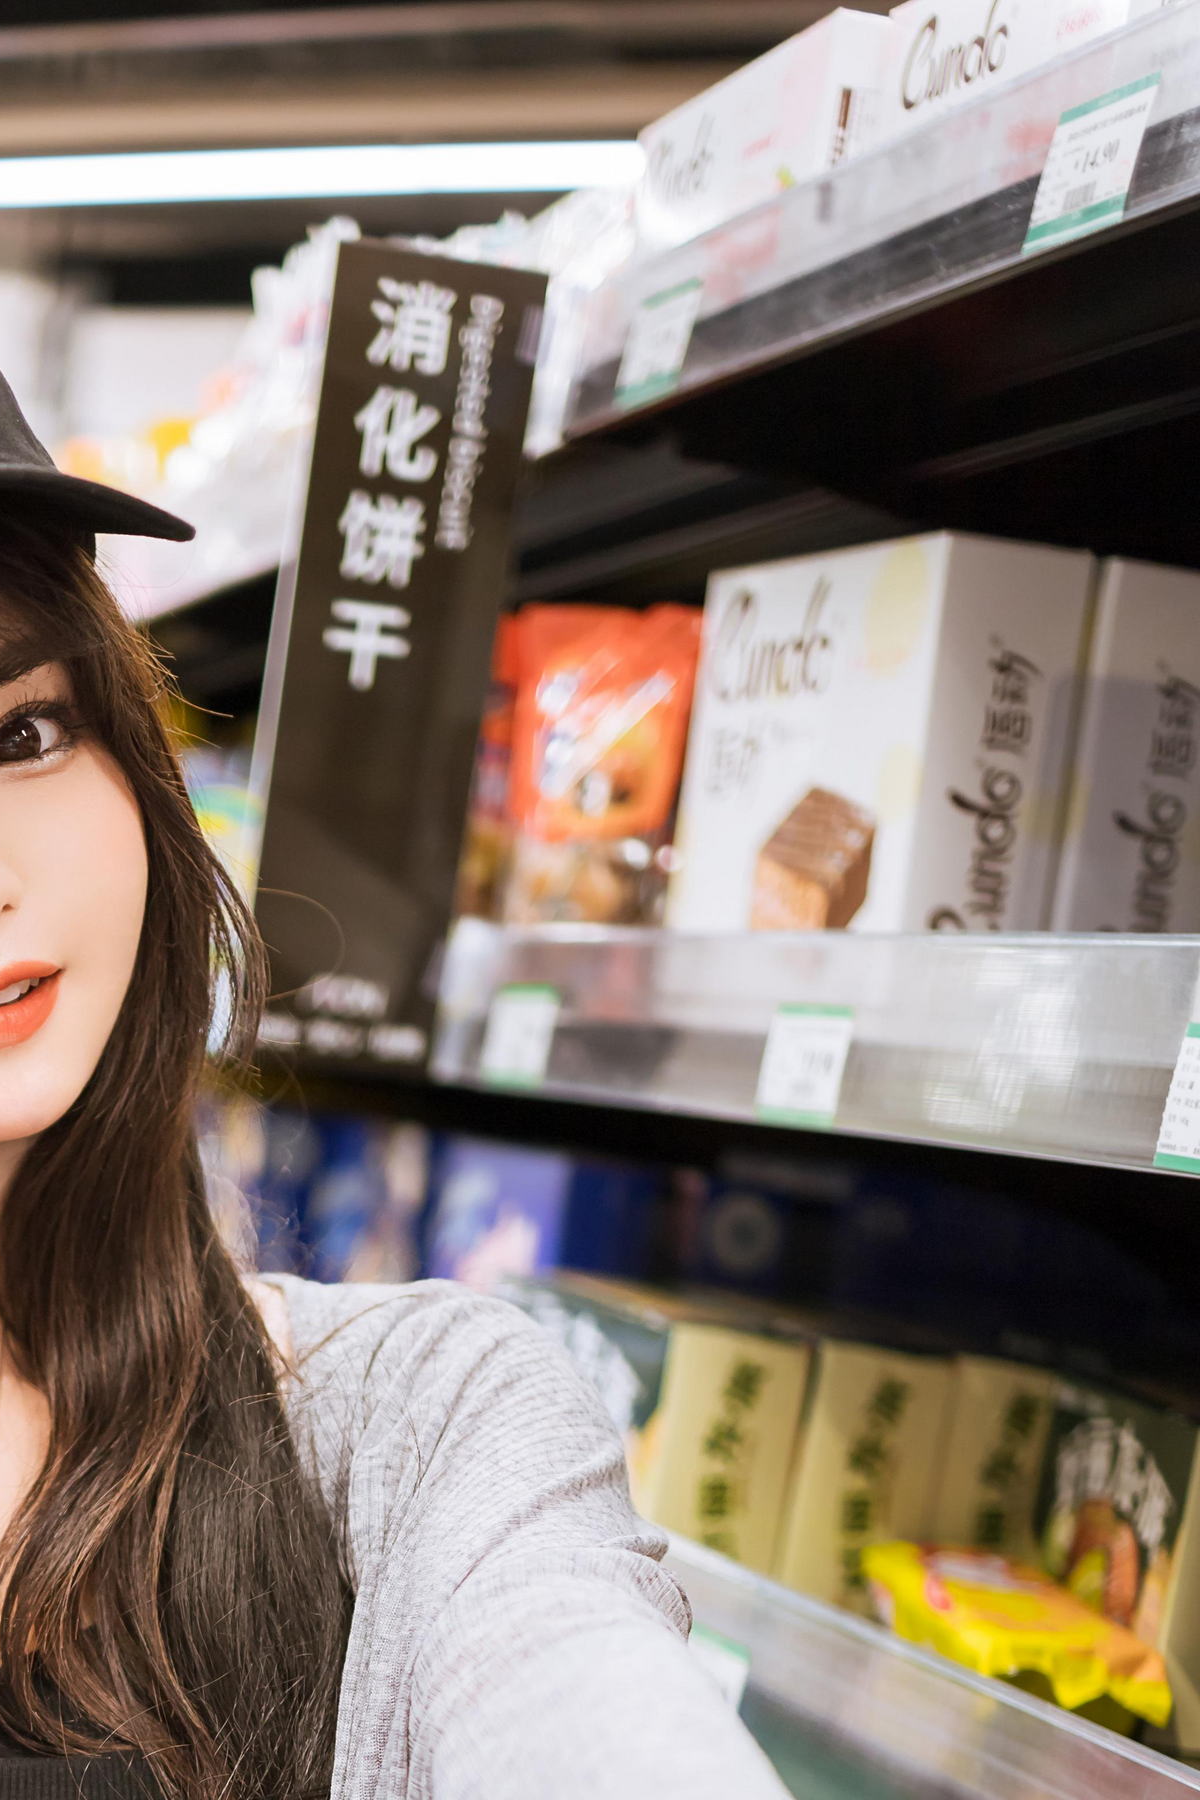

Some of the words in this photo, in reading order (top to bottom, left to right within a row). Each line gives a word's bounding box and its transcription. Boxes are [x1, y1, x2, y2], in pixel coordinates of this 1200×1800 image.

[323, 276, 457, 691] 消化饼干
[1112, 793, 1187, 932] undo
